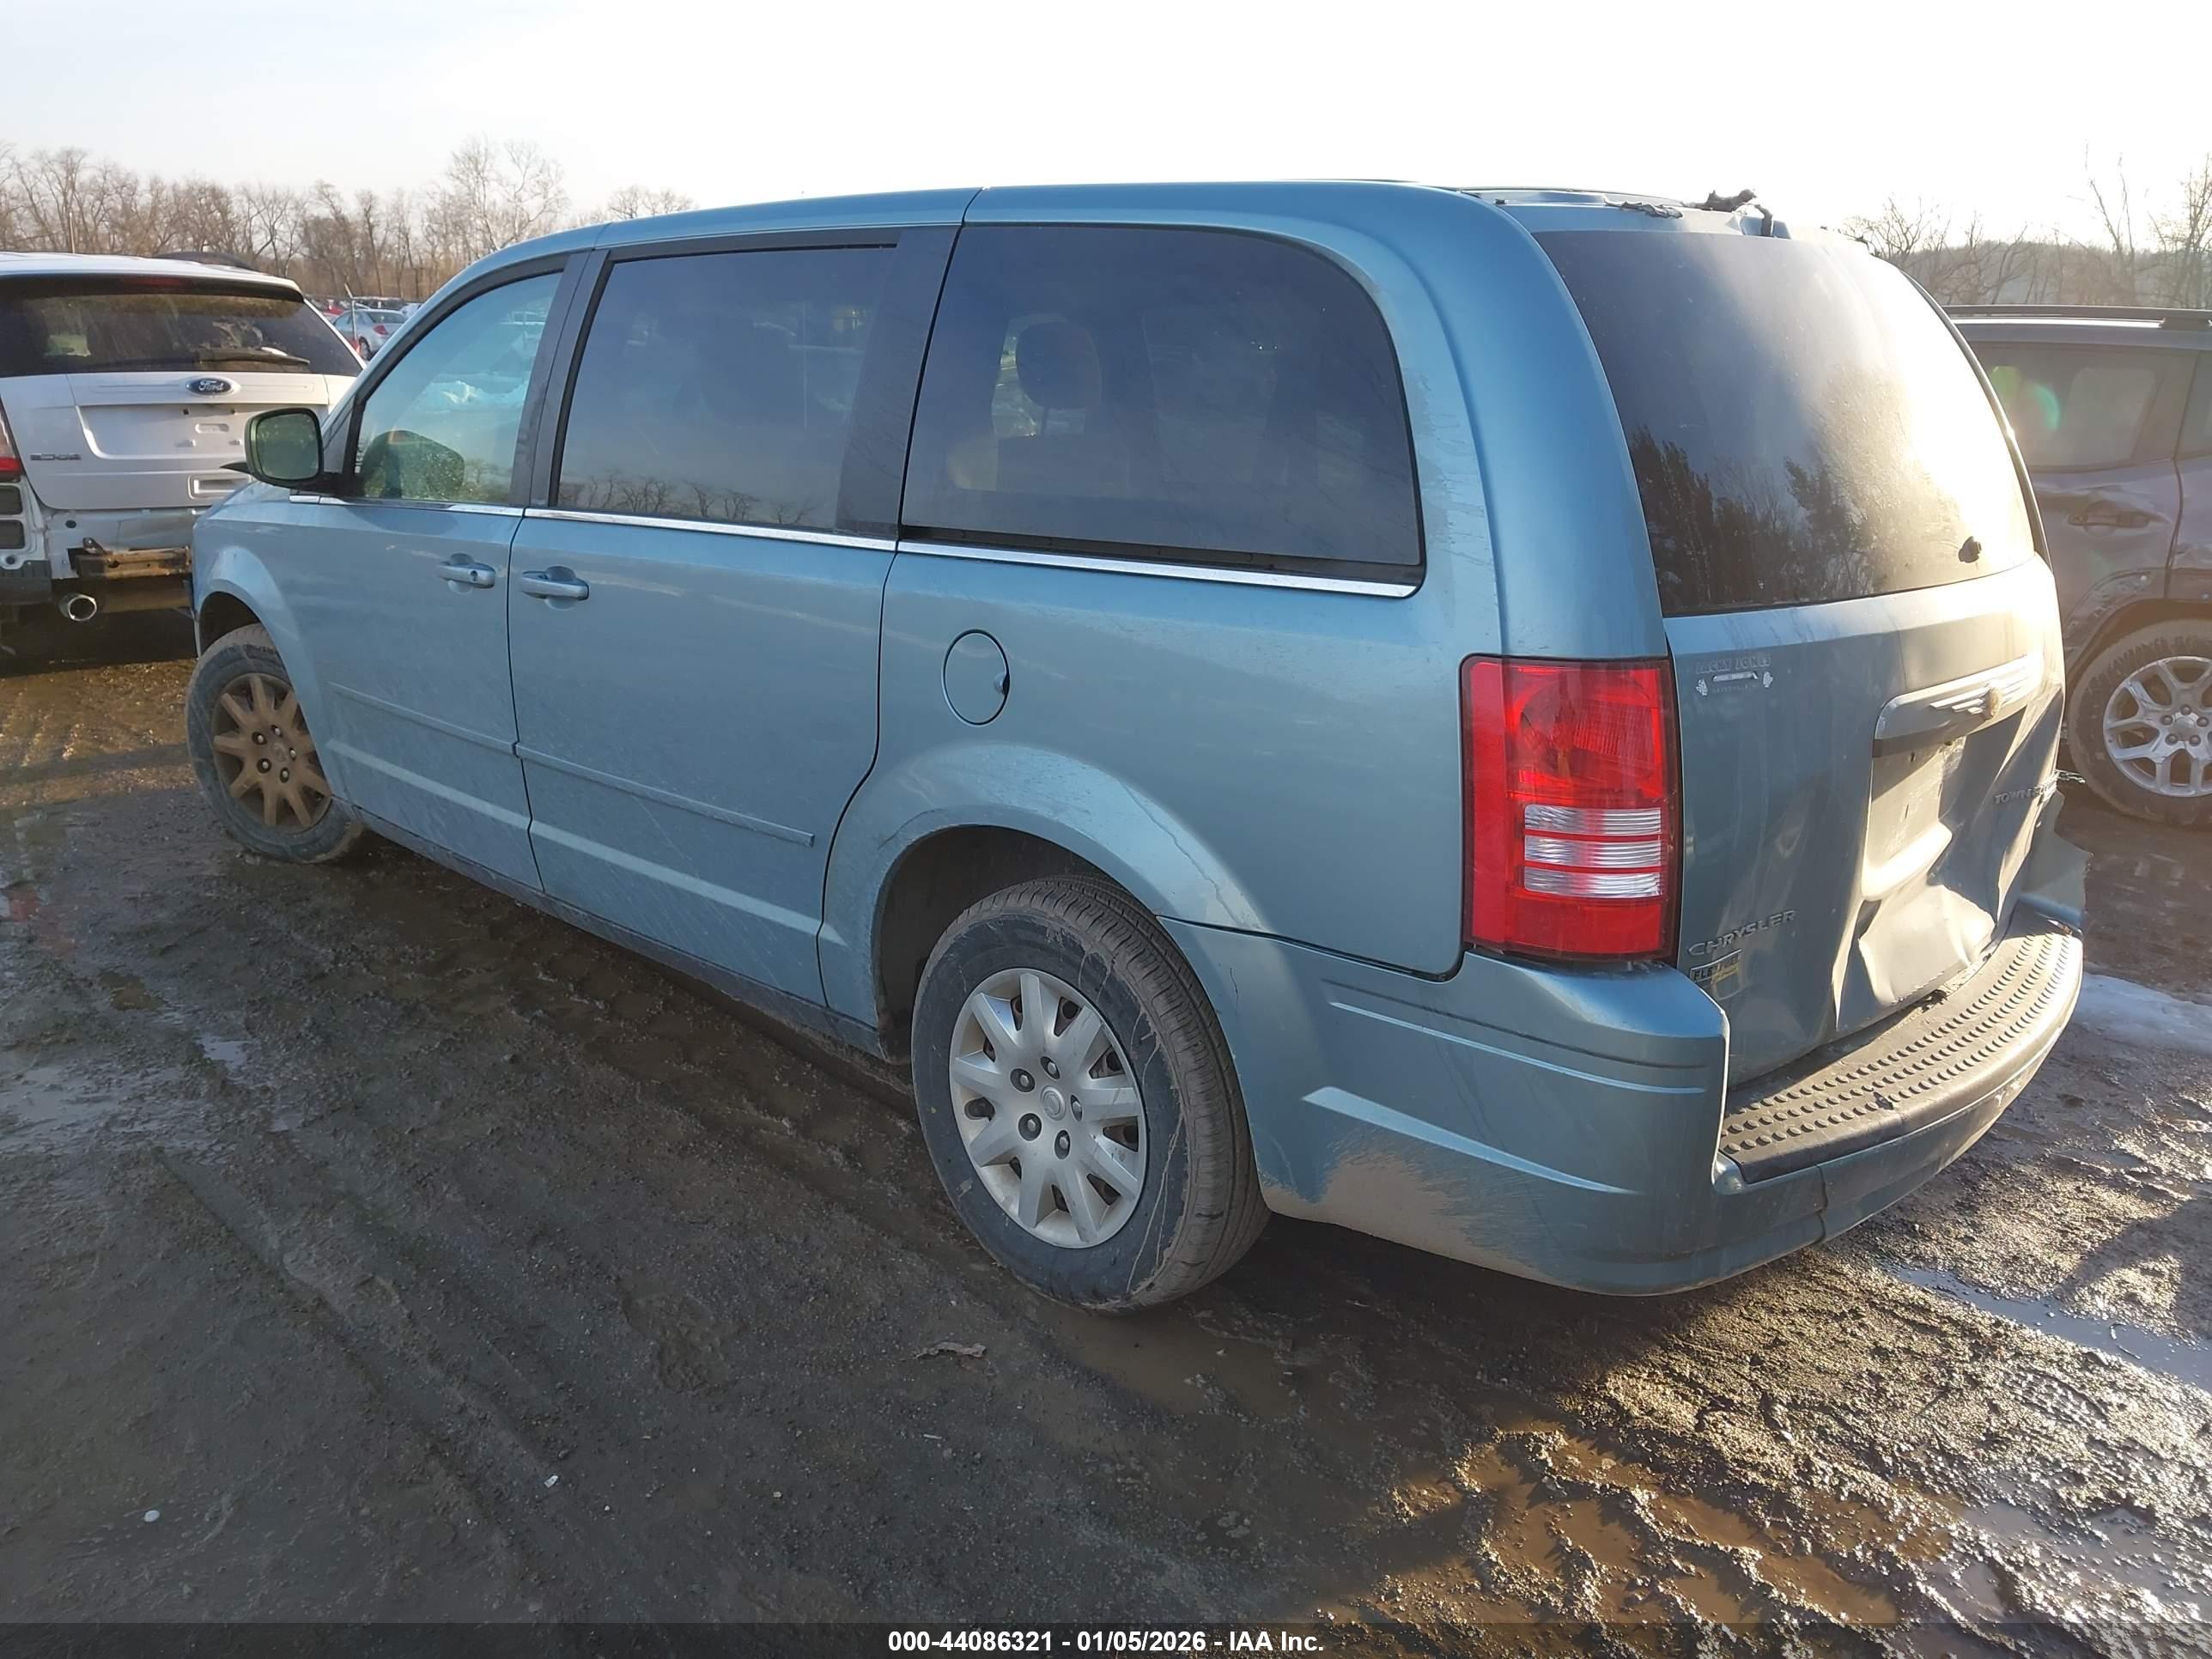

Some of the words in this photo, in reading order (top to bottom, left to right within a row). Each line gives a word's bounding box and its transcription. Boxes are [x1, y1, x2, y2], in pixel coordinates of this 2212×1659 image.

[198, 380, 224, 392] Ford
[1994, 787, 2032, 805] TOWN
[1687, 908, 1796, 956] CHRYSLER
